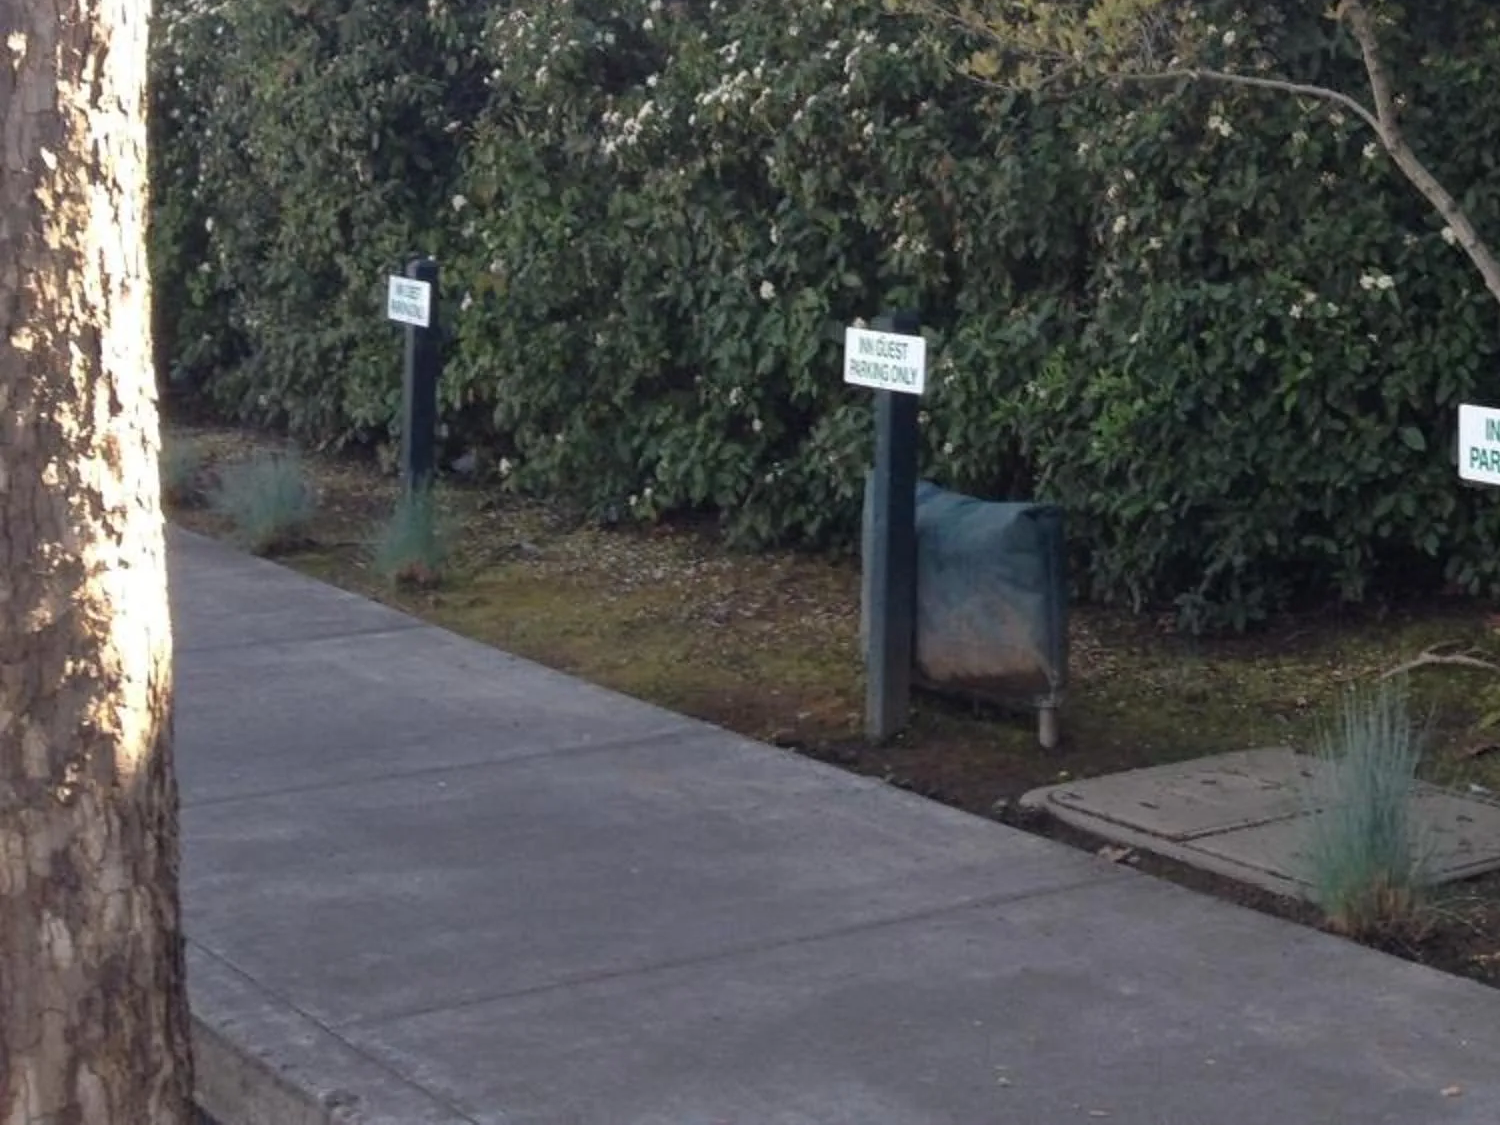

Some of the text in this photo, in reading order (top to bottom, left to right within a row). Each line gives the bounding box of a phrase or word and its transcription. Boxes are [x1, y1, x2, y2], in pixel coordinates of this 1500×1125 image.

[876, 338, 908, 361] GUEST
[849, 358, 918, 386] PARKING ONLY
